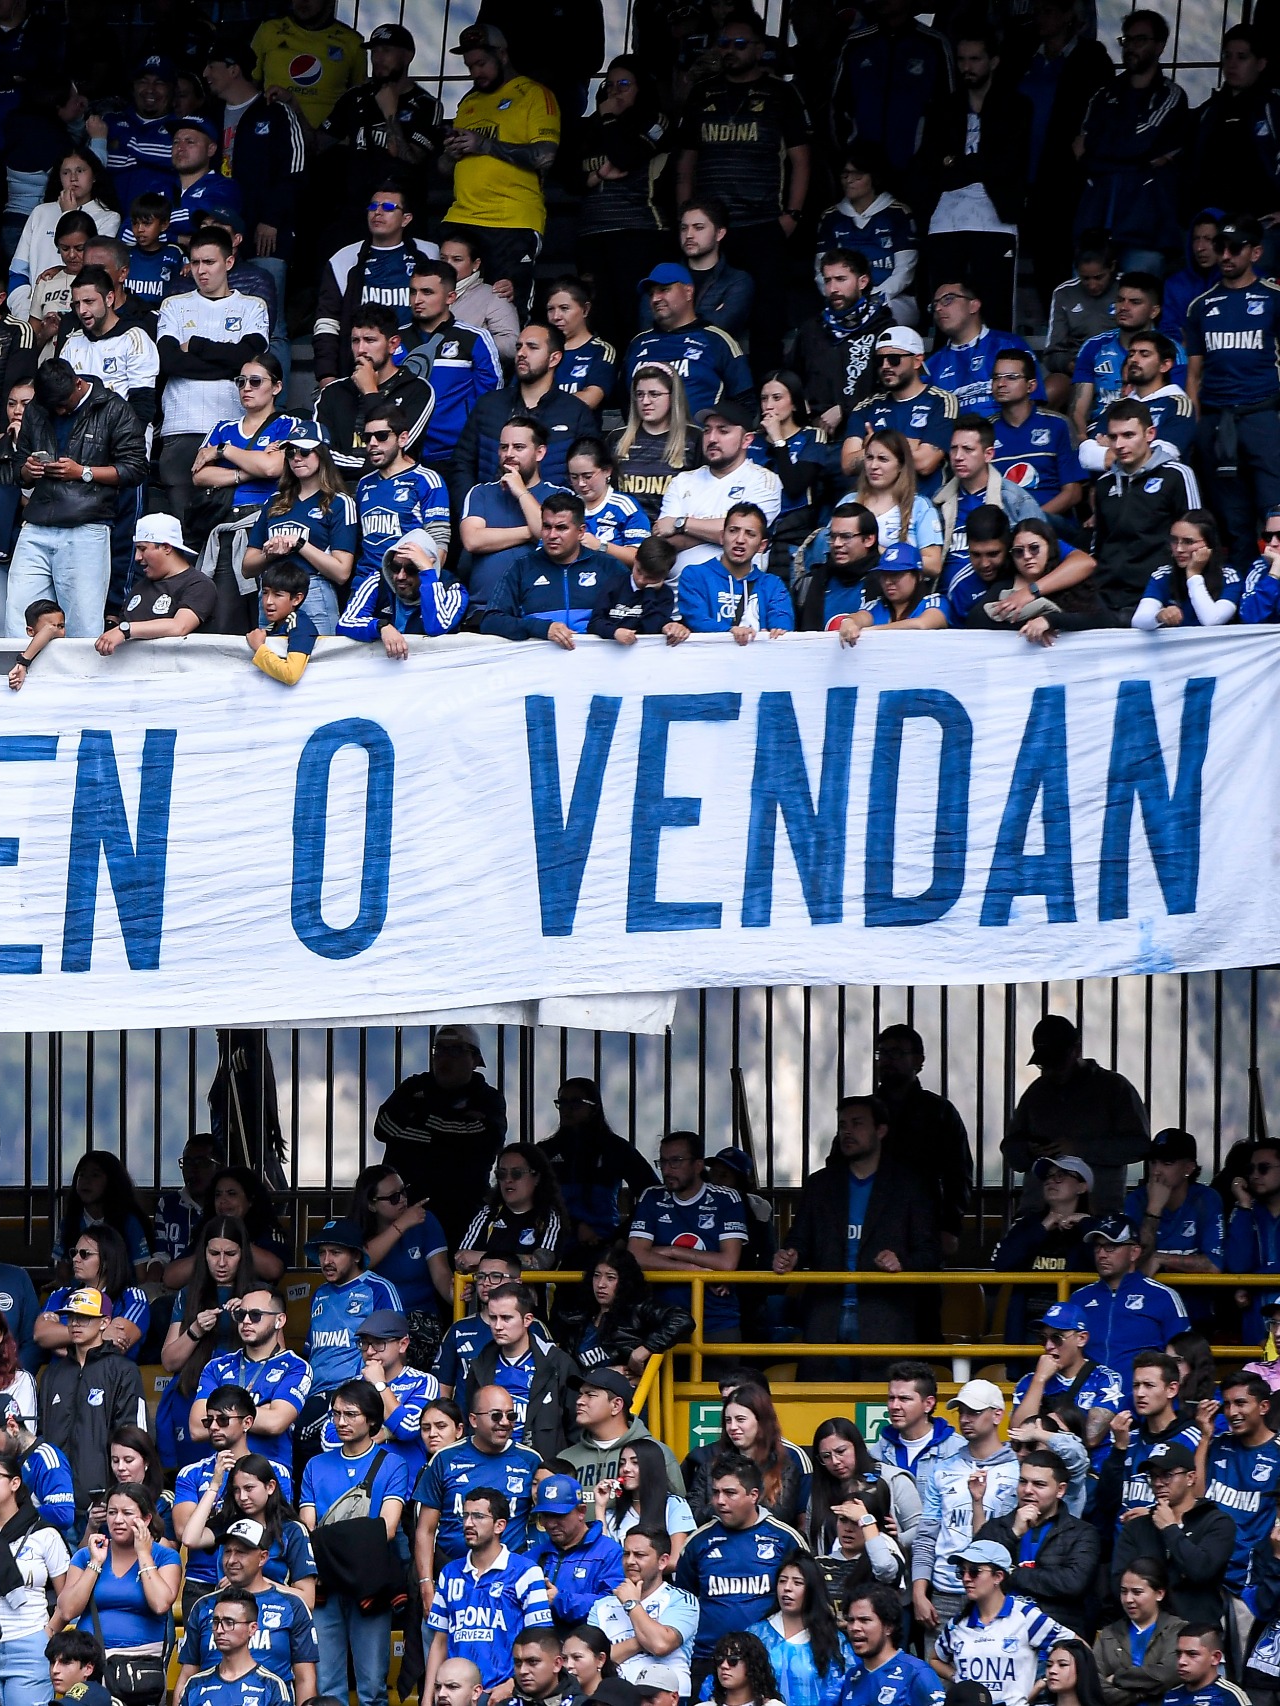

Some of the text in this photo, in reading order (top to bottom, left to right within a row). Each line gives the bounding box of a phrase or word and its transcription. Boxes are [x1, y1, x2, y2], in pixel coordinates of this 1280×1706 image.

[356, 127, 387, 147] ADI
[701, 121, 758, 142] ANDINA
[361, 285, 410, 307] ANDIN
[1205, 329, 1263, 353] ANDINA
[843, 364, 862, 396] GUNS
[618, 474, 674, 495] ANDINA
[290, 716, 395, 961] O
[524, 676, 1217, 937] VENDAN
[1032, 1256, 1067, 1270] ANDI
[162, 1380, 170, 1388] 10
[1205, 1479, 1261, 1513] ANDINA
[448, 1578, 465, 1603] 10
[708, 1574, 770, 1596] ANDINA
[448, 1606, 507, 1634] LEONA
[454, 1630, 493, 1642] CERVEZA
[958, 1657, 1016, 1682] EONA
